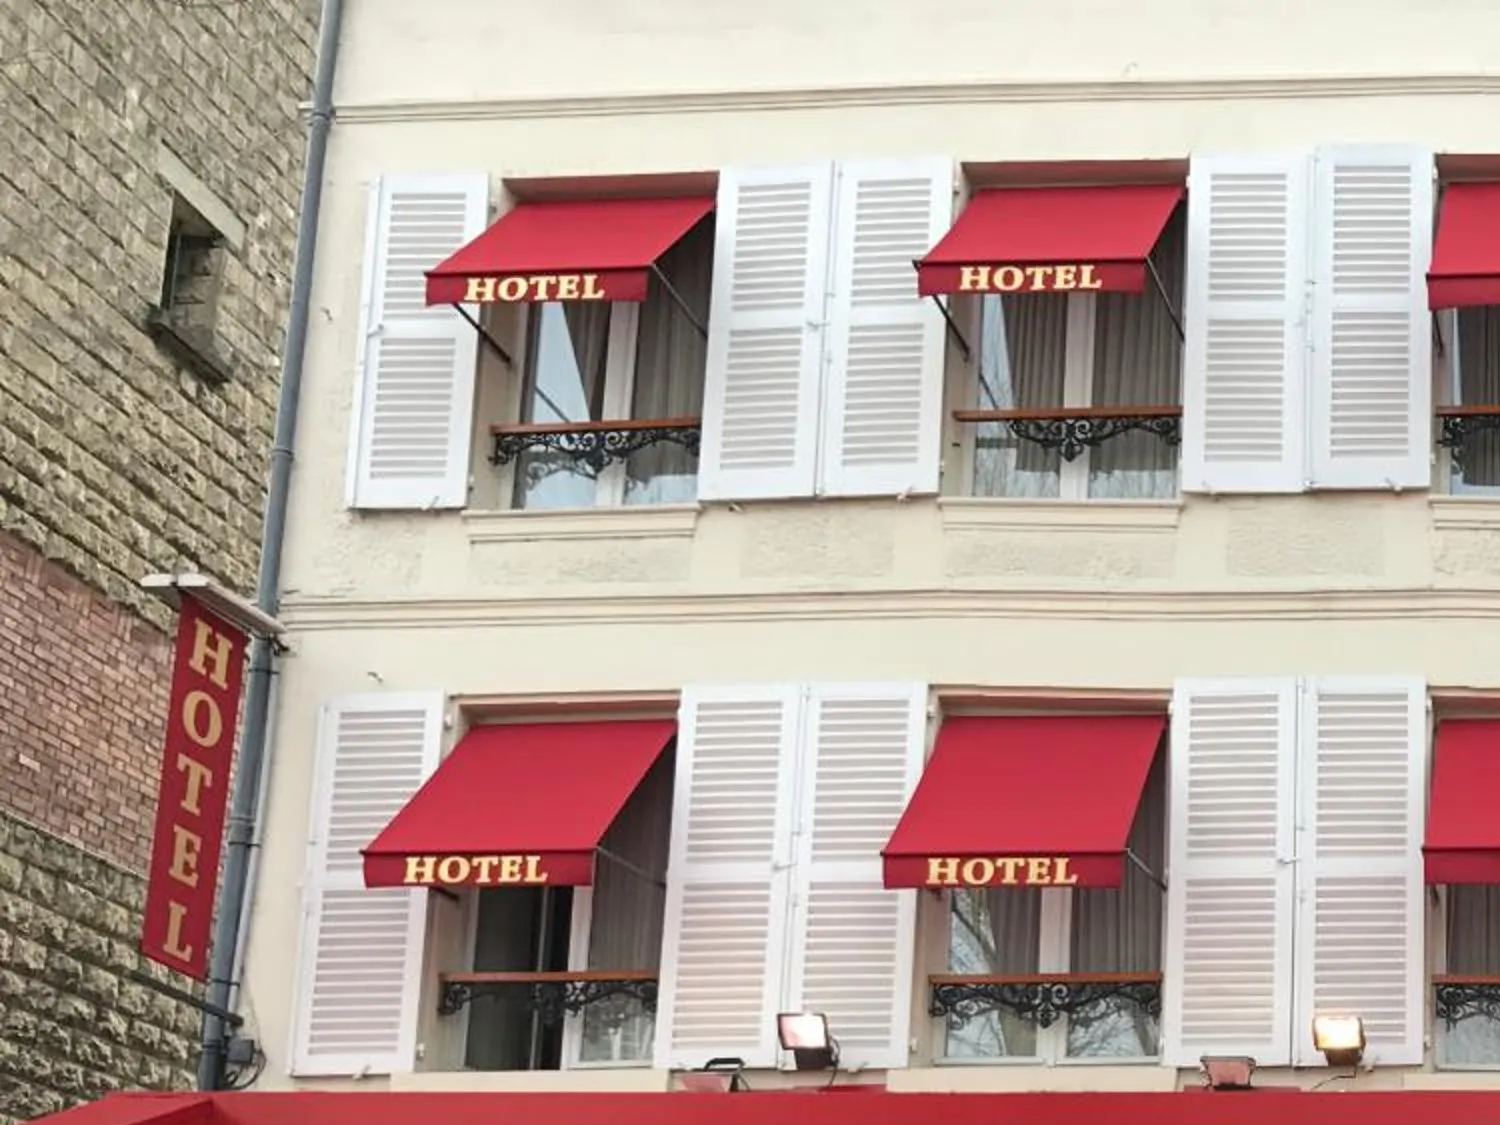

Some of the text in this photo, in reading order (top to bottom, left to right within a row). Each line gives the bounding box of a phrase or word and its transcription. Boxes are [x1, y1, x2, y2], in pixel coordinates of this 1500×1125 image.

[464, 275, 605, 302] HOTEL
[960, 265, 1103, 291] HOTEL
[163, 617, 232, 963] HOTEL
[404, 856, 548, 883] HOTEL
[927, 858, 1078, 884] HOTEL
